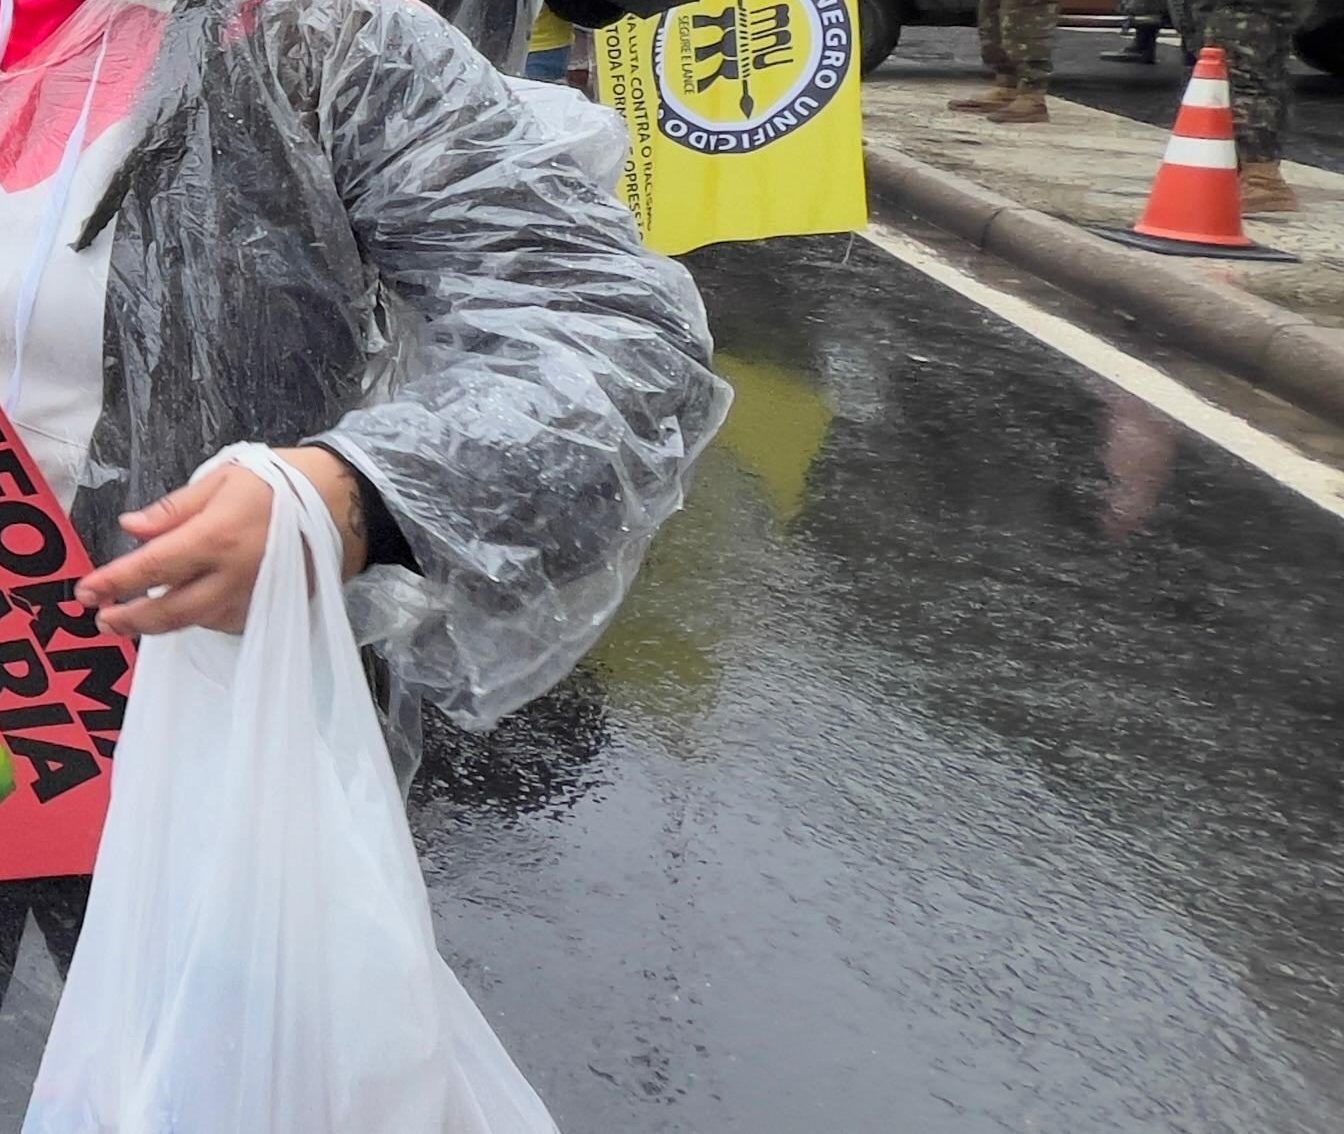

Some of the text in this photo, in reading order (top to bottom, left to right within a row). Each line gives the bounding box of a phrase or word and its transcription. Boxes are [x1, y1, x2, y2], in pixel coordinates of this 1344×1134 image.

[606, 25, 623, 72] TODA
[628, 36, 640, 74] LUTA
[682, 64, 695, 95] LANCE
[630, 77, 651, 144] CONTRA
[641, 145, 652, 158] O
